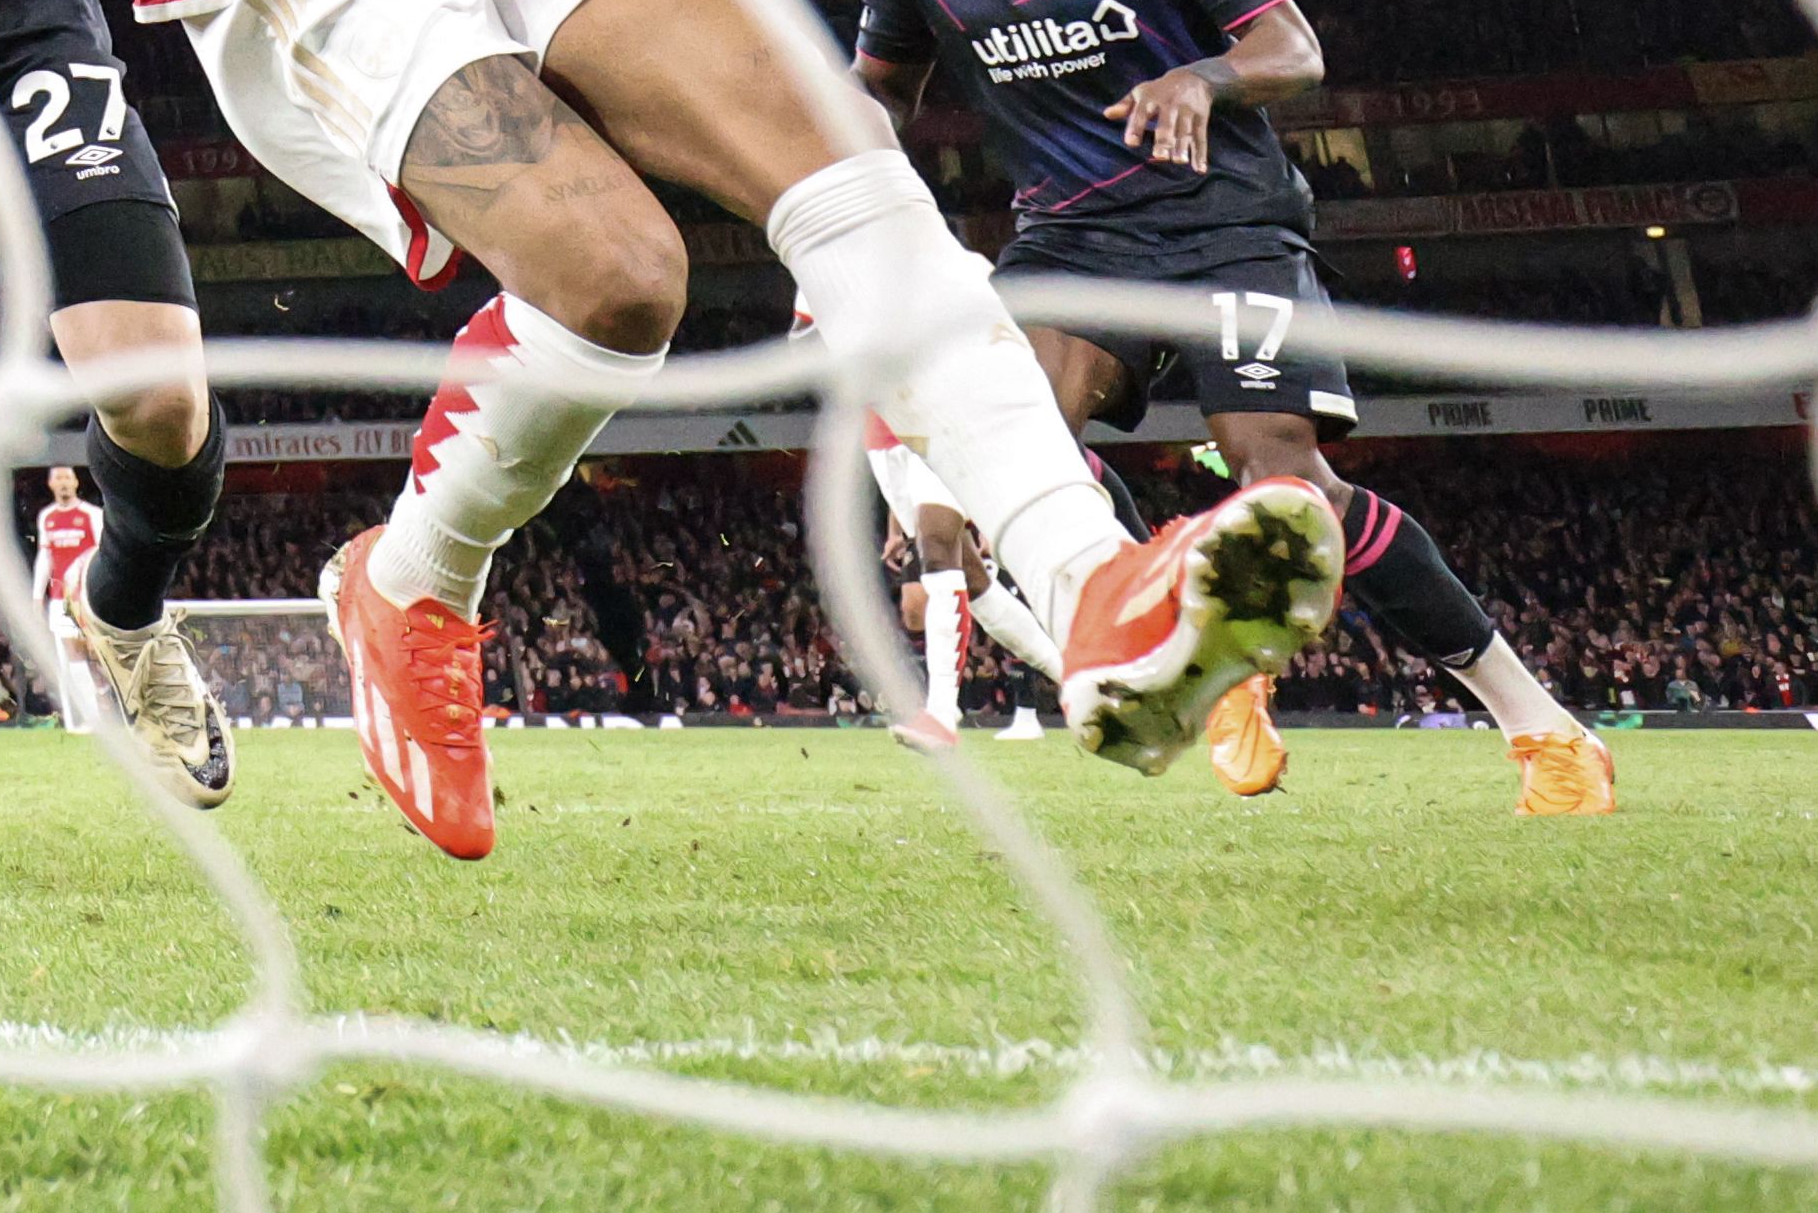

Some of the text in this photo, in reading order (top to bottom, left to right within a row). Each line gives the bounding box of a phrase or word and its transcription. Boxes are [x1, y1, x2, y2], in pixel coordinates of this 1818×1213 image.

[972, 18, 1100, 65] utilita
[988, 51, 1107, 84] life with power
[11, 62, 127, 164] 27
[76, 164, 121, 180] umbro
[1212, 292, 1293, 361] 17
[1583, 397, 1653, 424] PRIME
[235, 433, 342, 457] mirates
